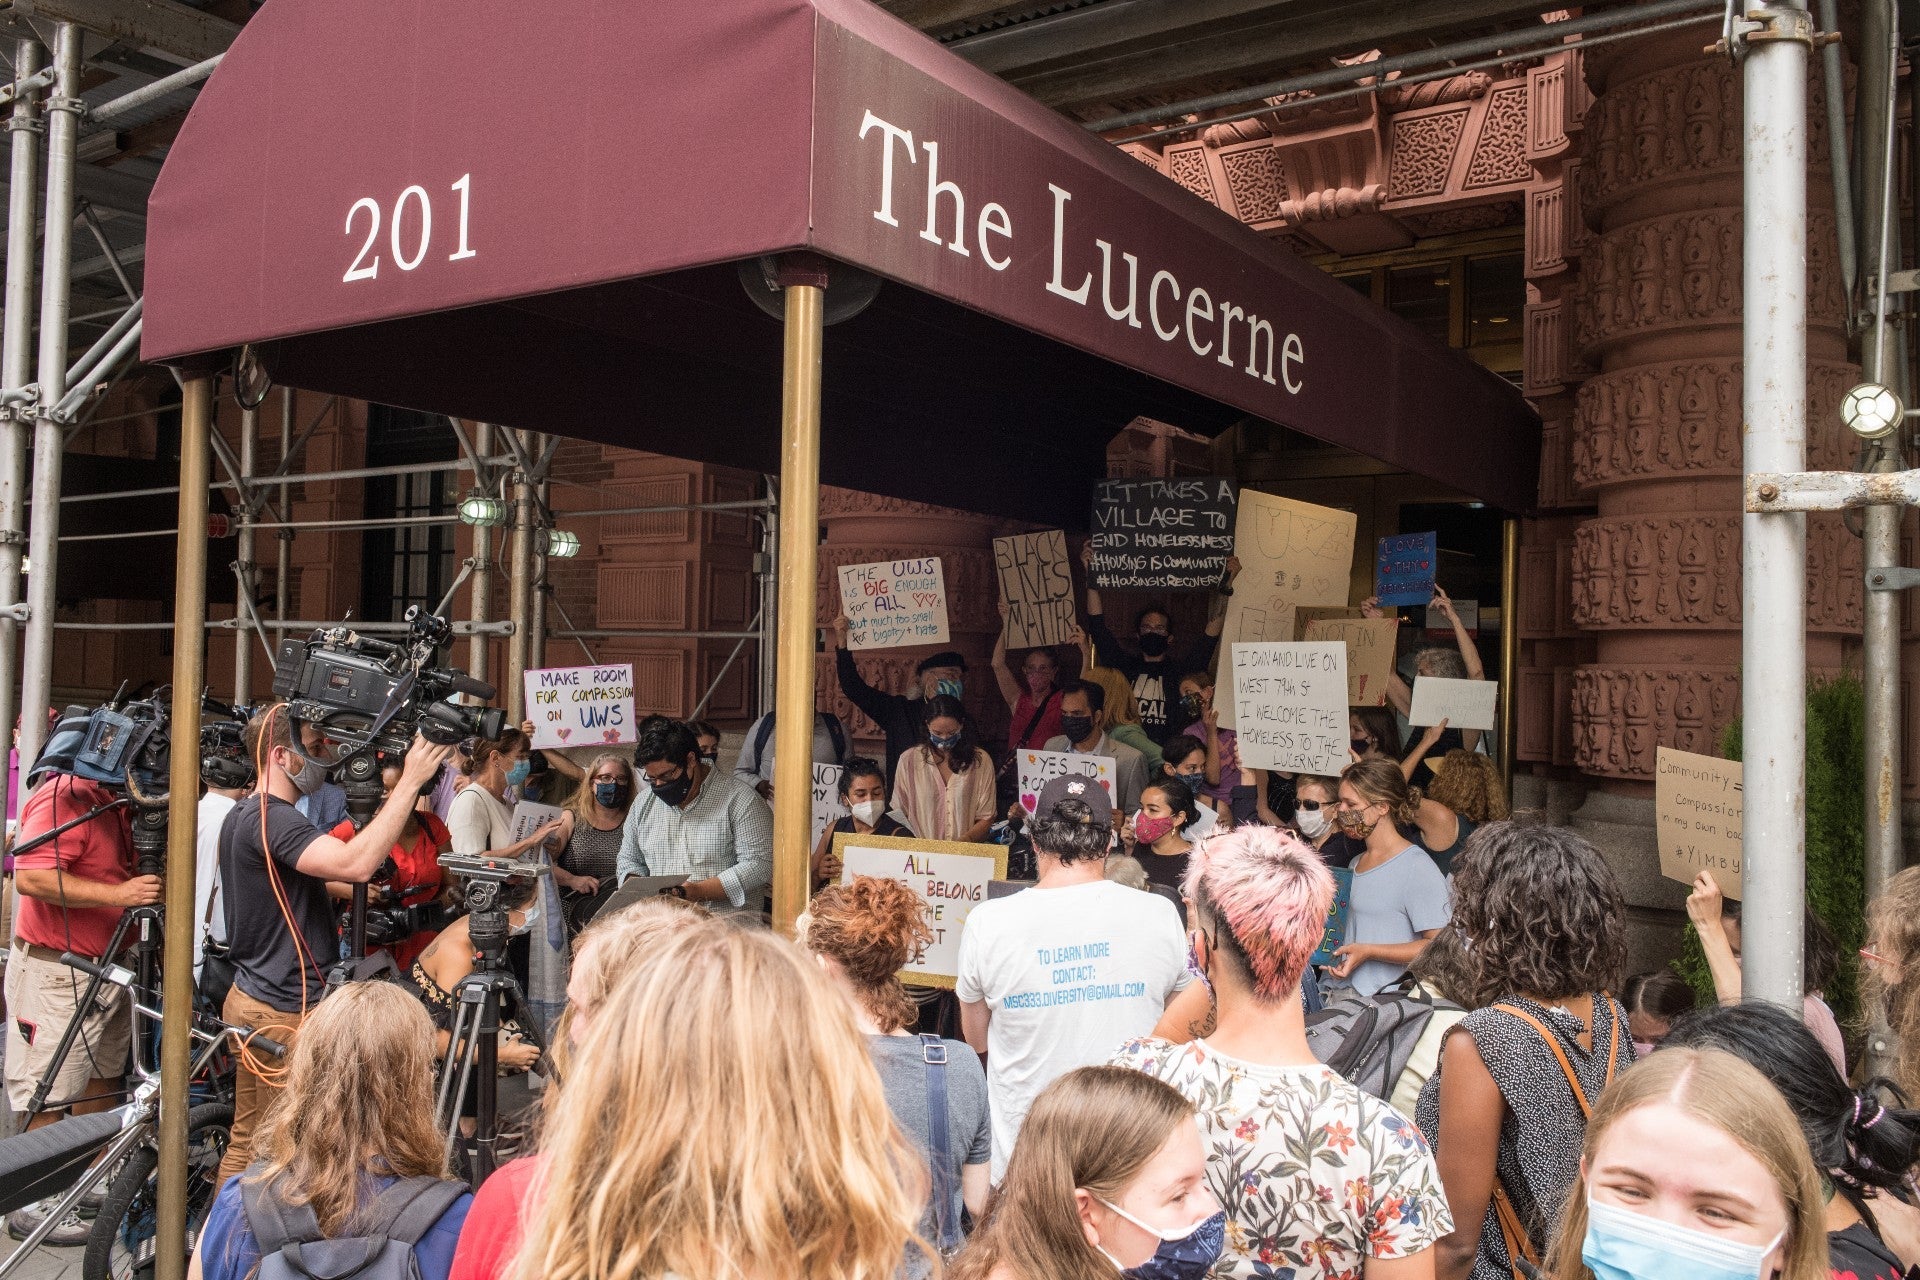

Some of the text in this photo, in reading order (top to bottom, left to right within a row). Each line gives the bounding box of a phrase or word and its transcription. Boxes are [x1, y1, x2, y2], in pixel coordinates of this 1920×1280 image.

[342, 172, 477, 283] 201
[858, 109, 1304, 395] The Lucerne
[1098, 479, 1236, 504] IT TAKES A
[1095, 506, 1227, 530] VILLAGE TO
[994, 530, 1068, 569] BLACK
[1091, 532, 1234, 551] END HOMELESSNESS
[1383, 537, 1424, 554] LOVE
[844, 566, 878, 583] THE
[1090, 553, 1147, 574] #HOUSING
[1150, 555, 1162, 571] IS
[1394, 560, 1419, 574] THY
[863, 580, 889, 596] BIG
[894, 577, 937, 592] ENOUGH
[1001, 560, 1071, 606] LIVES
[850, 594, 906, 616] for ALL
[870, 614, 892, 627] much
[894, 615, 910, 624] too
[912, 610, 934, 624] small
[1006, 599, 1075, 648] MATTER
[852, 631, 868, 646] for
[872, 628, 906, 644] bigotry
[915, 623, 938, 636] hate
[1356, 626, 1376, 648] IN
[1237, 650, 1249, 667] I
[1272, 650, 1292, 667] AND
[1295, 651, 1319, 669] LIVE
[1322, 652, 1337, 672] ON
[540, 669, 628, 688] MAKE ROOM
[1240, 677, 1269, 695] WEST
[535, 686, 634, 705] FOR COMPASSION
[546, 704, 624, 729] ON UWS
[1136, 699, 1167, 719] CAL
[1239, 700, 1341, 729] I WELCOME THE
[1140, 717, 1166, 725] YORK
[1241, 726, 1343, 758] HOMELESS TO THE
[1038, 756, 1098, 779] YES TO
[1273, 750, 1330, 773] LUCERNE!
[1659, 756, 1730, 792] Community
[1674, 817, 1688, 829] my
[1695, 821, 1716, 835] own
[903, 854, 936, 875] ALL
[1675, 844, 1741, 874] #YIMBY
[926, 879, 982, 901] BELONG
[925, 904, 945, 921] HE
[1037, 942, 1110, 966] TO LEARN MORE
[1052, 965, 1096, 985] CONTACT:
[1003, 982, 1145, 1010] MSC333.DIVERSITY@GMAIL.COM
